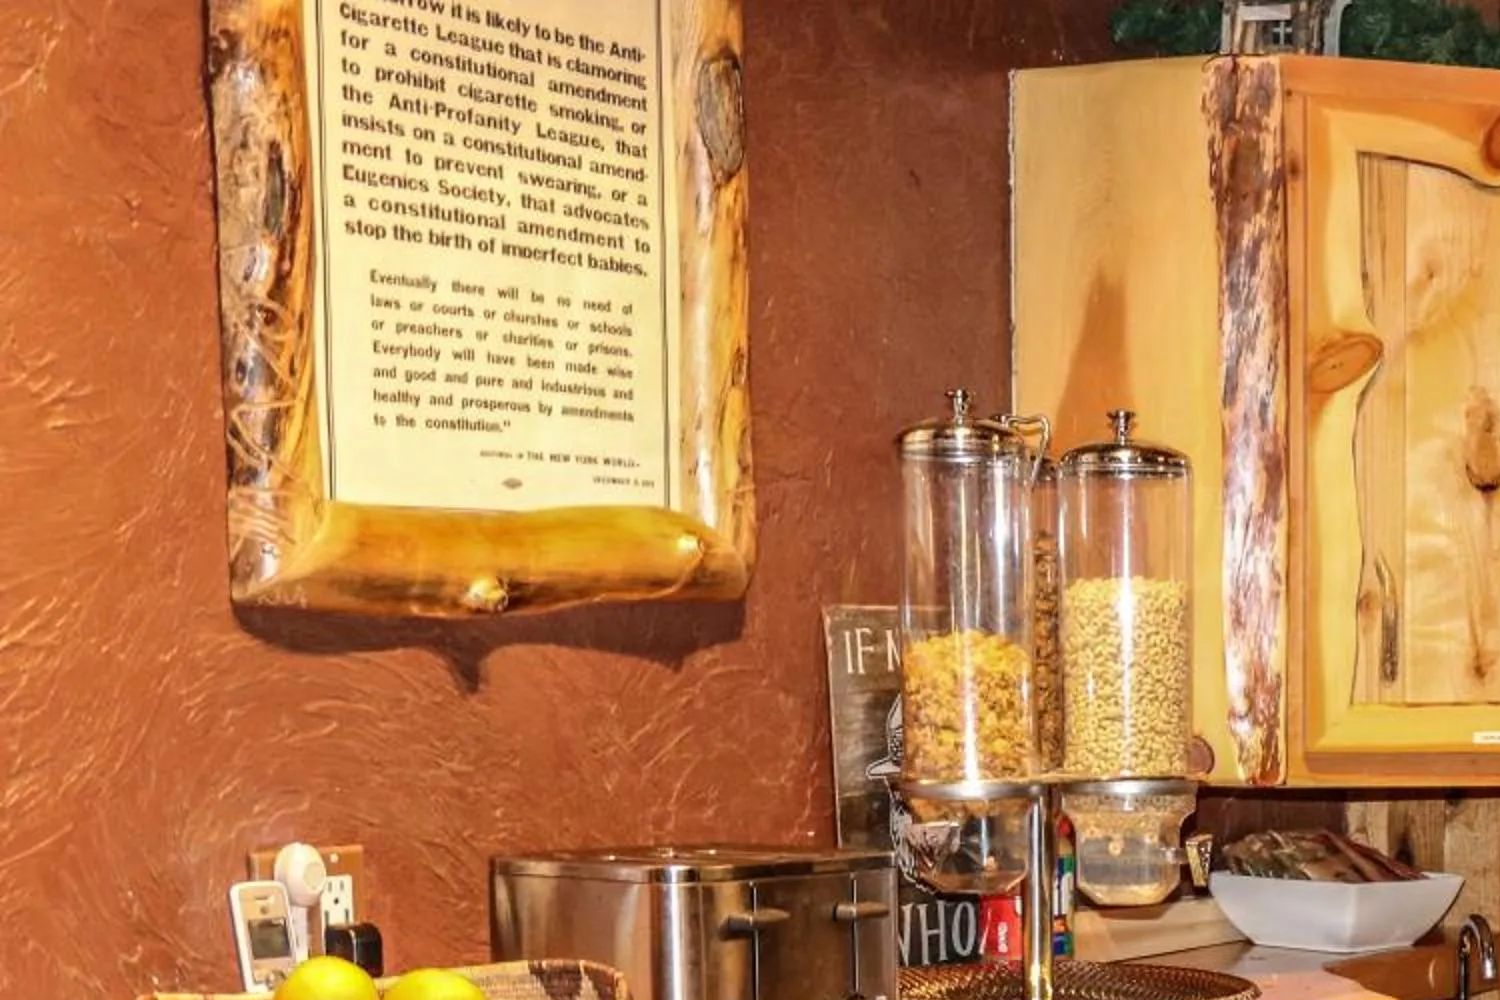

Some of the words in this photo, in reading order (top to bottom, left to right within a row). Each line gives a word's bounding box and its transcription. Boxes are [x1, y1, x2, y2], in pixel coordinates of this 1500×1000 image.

[339, 2, 429, 37] Cigarette
[435, 23, 505, 54] League
[508, 41, 543, 64] that
[547, 52, 562, 69] is
[566, 56, 648, 91] clamoring
[450, 2, 463, 20] it
[466, 8, 481, 24] is
[485, 9, 531, 38] likely
[534, 24, 551, 42] to
[554, 28, 575, 47] be
[579, 34, 605, 54] the
[340, 29, 371, 51] for
[384, 42, 398, 57] a
[410, 48, 536, 88] constitutional
[548, 75, 649, 112] amendment
[341, 56, 361, 76] to
[375, 66, 447, 93] prohibit
[457, 82, 539, 113] cigarette
[631, 122, 648, 135] or
[341, 83, 374, 105] the
[615, 138, 649, 159] that
[342, 111, 406, 137] insists
[413, 127, 437, 143] on
[443, 132, 457, 146] a
[462, 136, 583, 170] constitutional
[342, 140, 393, 160] ment
[405, 148, 424, 166] to
[434, 156, 505, 180] prevent
[611, 189, 629, 203] or
[637, 194, 649, 207] a
[342, 163, 431, 192] Eugenics
[520, 193, 556, 214] that
[563, 198, 651, 231] advocates
[344, 194, 357, 208] a
[368, 198, 507, 230] constitutional
[517, 221, 625, 250] amendment
[634, 236, 651, 254] to
[344, 219, 388, 240] stop
[392, 224, 424, 244] the
[428, 228, 473, 251] birth
[477, 237, 497, 254] of
[501, 241, 584, 267] imperfect
[587, 252, 649, 277] babies.
[370, 269, 438, 293] Eventually
[451, 280, 486, 296] there
[497, 287, 520, 300] will
[531, 290, 545, 304] be
[622, 304, 634, 315] of
[370, 294, 402, 310] laws
[409, 301, 425, 311] or
[432, 304, 476, 318] courts
[483, 309, 497, 320] or
[567, 320, 581, 330] or
[371, 320, 386, 330] or
[395, 322, 464, 339] preachers
[475, 331, 490, 341] or
[502, 330, 555, 349] charities
[565, 341, 579, 351] or
[372, 340, 442, 362] Everybody
[452, 348, 476, 361] will
[486, 351, 517, 366] have
[526, 354, 556, 369] been
[565, 362, 599, 375] made
[373, 366, 398, 379] and
[404, 369, 438, 383] good
[444, 372, 469, 384] and
[475, 375, 505, 388] pure
[512, 377, 534, 391] and
[612, 389, 635, 400] and
[373, 388, 421, 408] healthy
[429, 394, 455, 407] and
[461, 398, 532, 413] prosperous
[538, 401, 554, 416] by
[373, 413, 388, 427] to
[395, 414, 417, 428] the
[844, 628, 875, 675] IF
